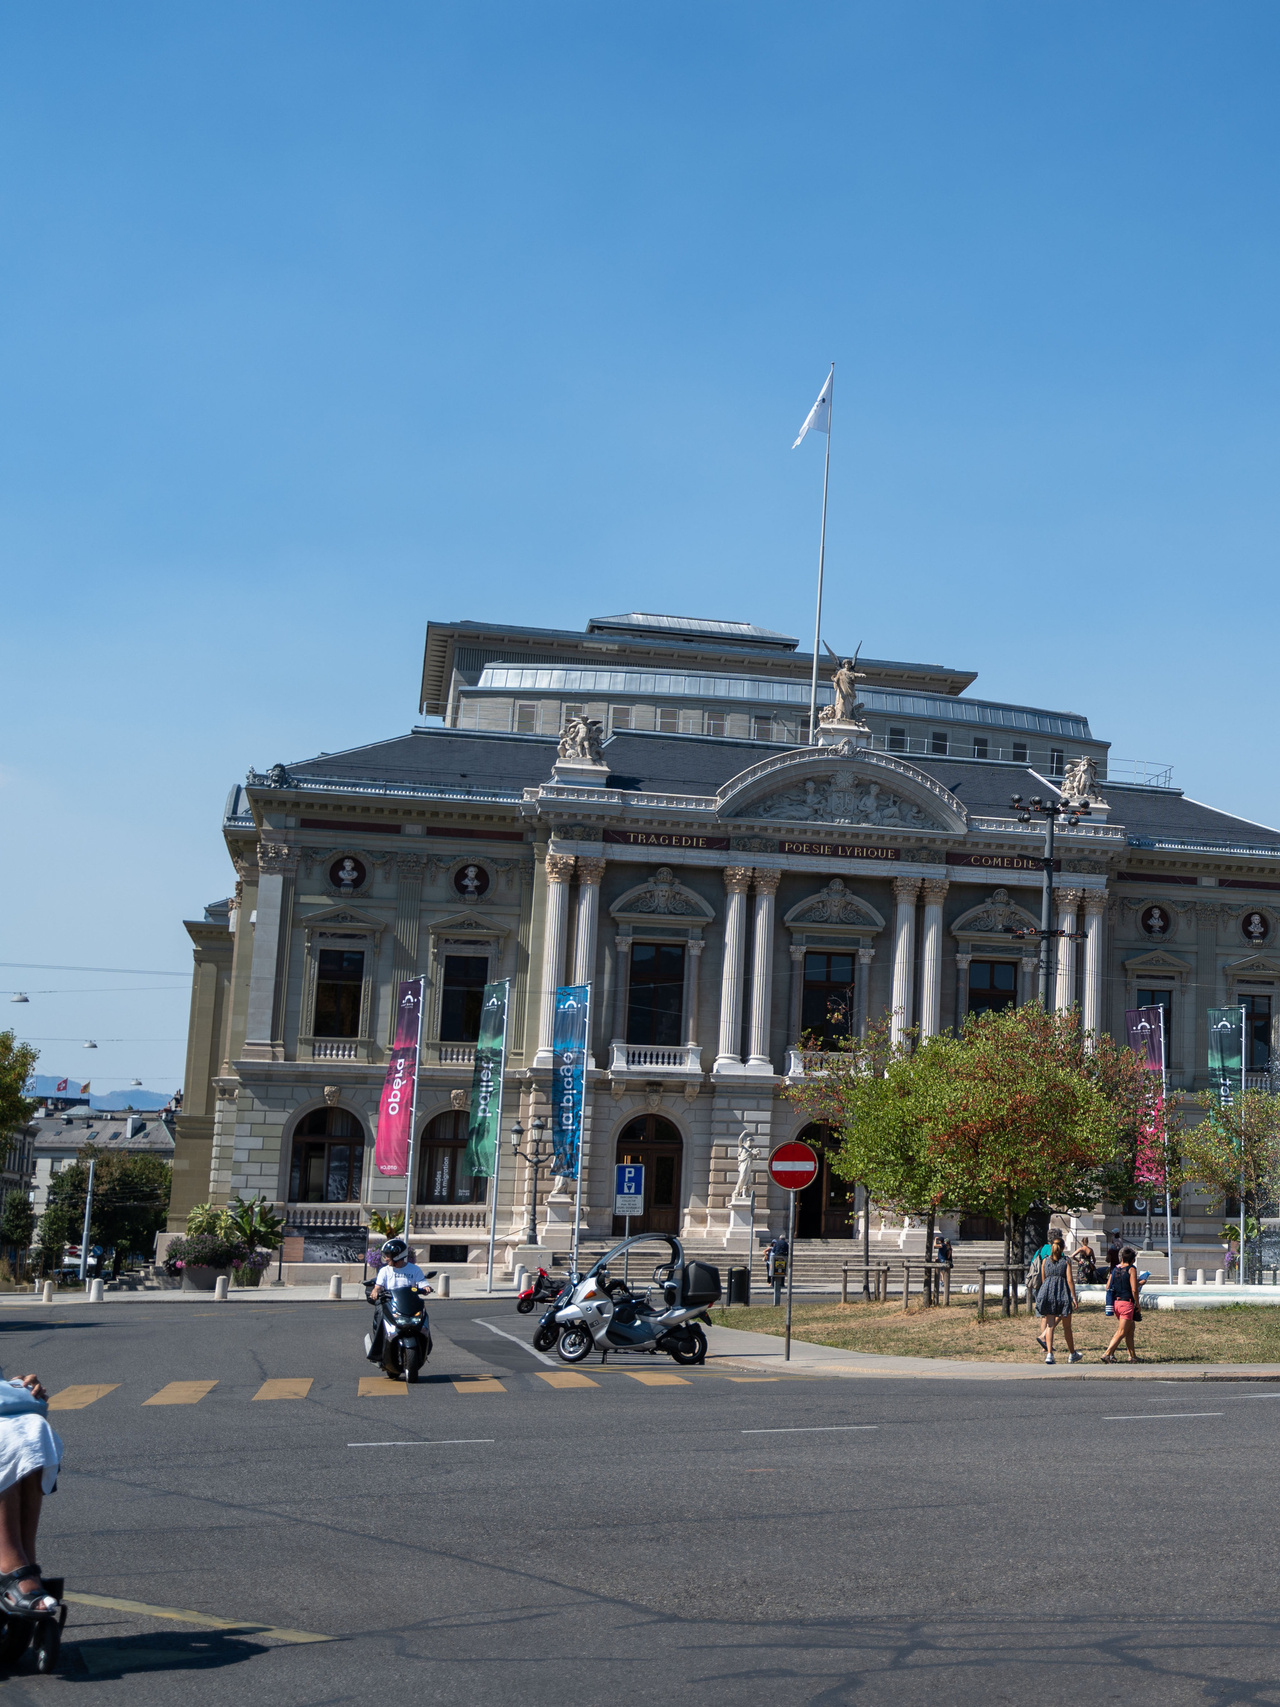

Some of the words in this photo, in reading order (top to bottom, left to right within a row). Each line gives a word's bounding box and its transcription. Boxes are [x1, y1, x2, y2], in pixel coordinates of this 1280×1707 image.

[626, 832, 707, 848] TRAGEDIE
[785, 842, 832, 855] POESIE
[838, 846, 896, 859] LYRIQUE
[971, 856, 1036, 870] COMEDIE
[442, 1156, 450, 1186] migration
[625, 1168, 635, 1182] P
[433, 1171, 442, 1196] Mondes
[442, 1187, 448, 1196] en
